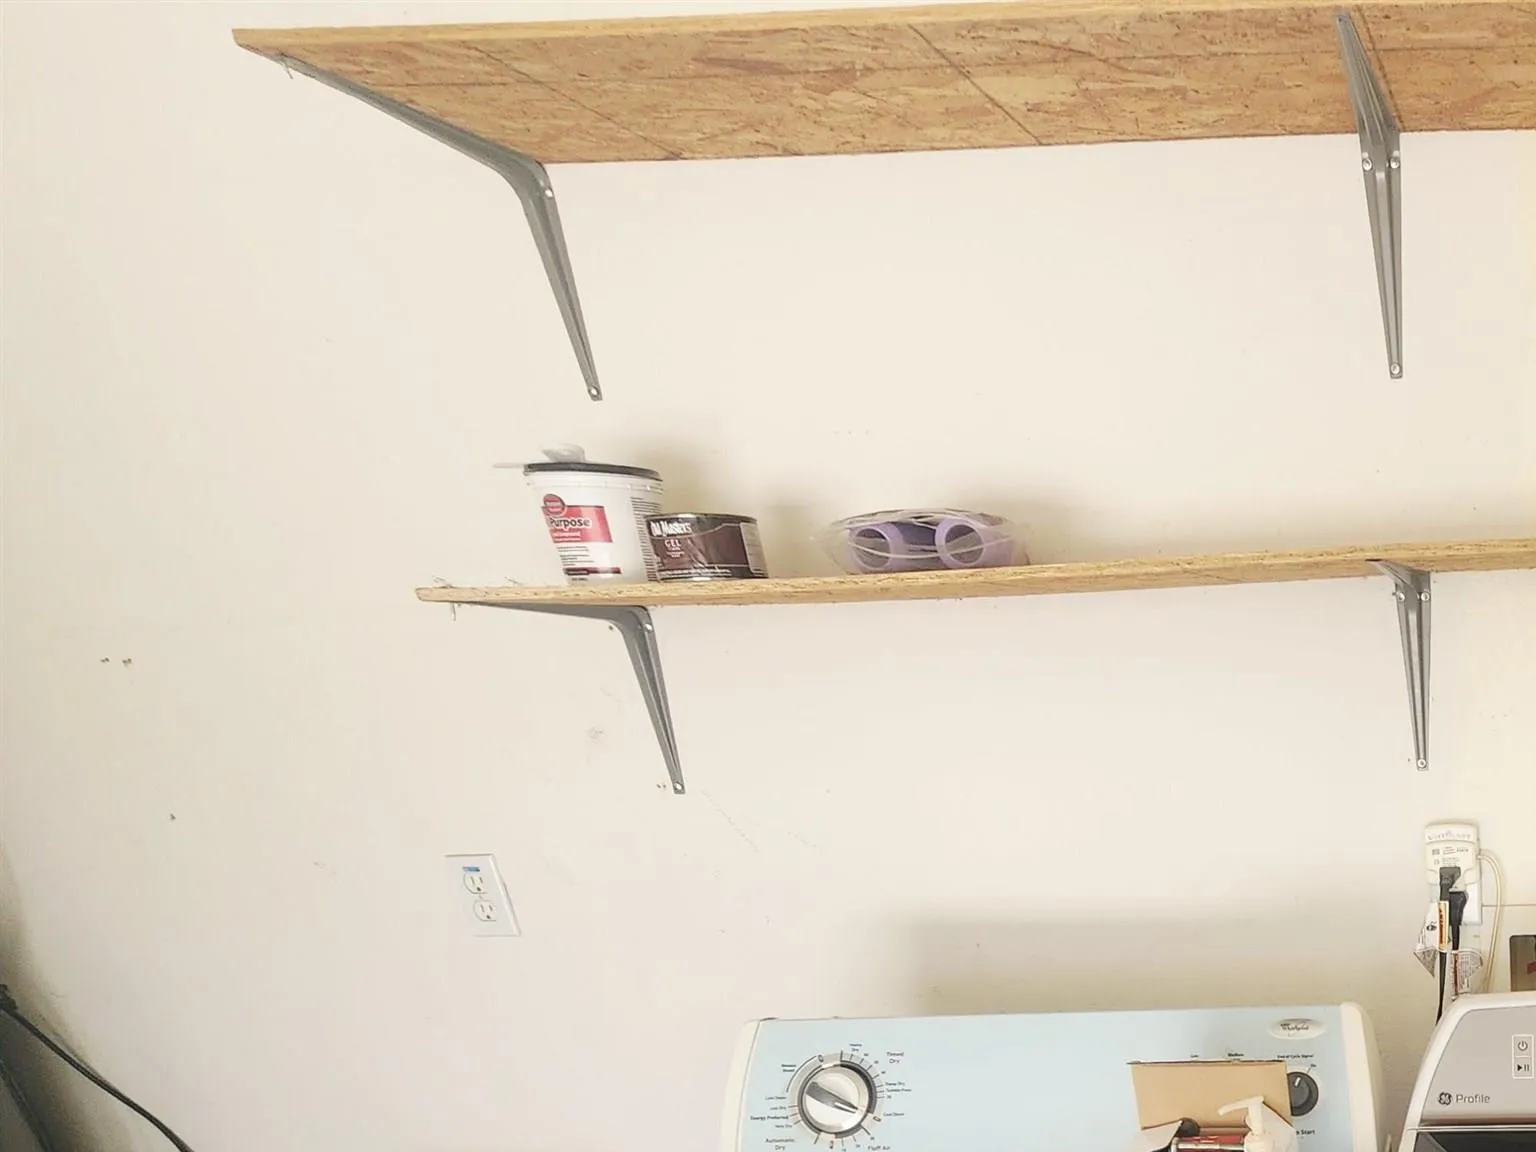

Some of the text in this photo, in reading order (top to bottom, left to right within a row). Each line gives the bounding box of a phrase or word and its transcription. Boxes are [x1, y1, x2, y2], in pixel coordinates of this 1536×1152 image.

[549, 517, 591, 531] Purpose
[664, 539, 682, 548] GEL
[1456, 1093, 1491, 1104] Profile
[774, 1144, 786, 1152] Dry
